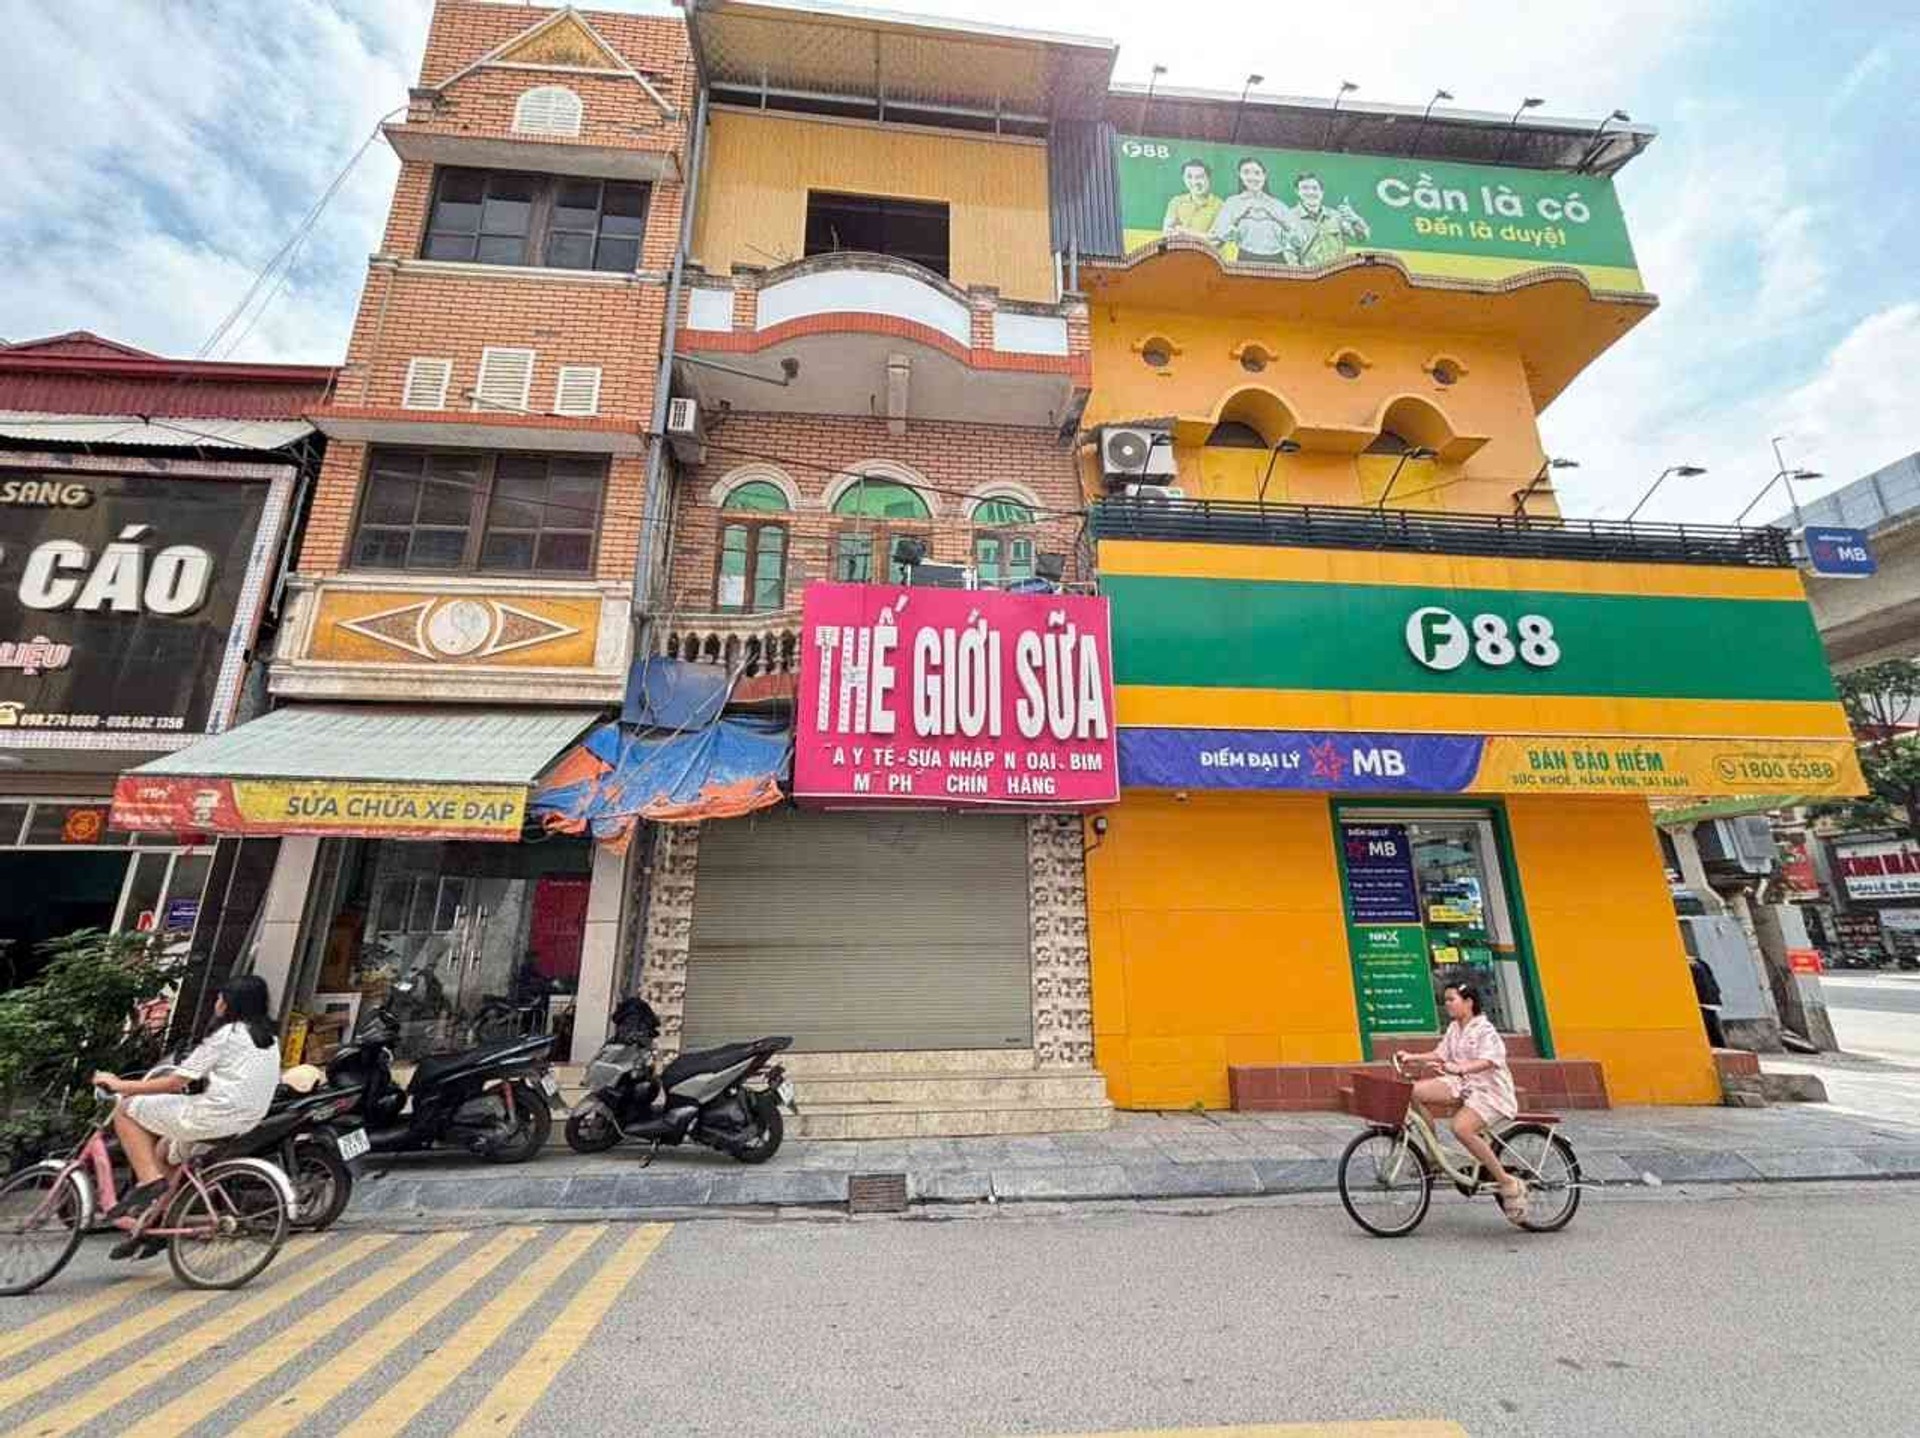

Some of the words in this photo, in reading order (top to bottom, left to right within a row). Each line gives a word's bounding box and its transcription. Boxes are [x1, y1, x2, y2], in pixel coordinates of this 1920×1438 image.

[1377, 173, 1469, 213] Cần
[1481, 184, 1525, 217] là
[1536, 192, 1590, 223] có
[1415, 215, 1463, 238] Đến
[1469, 220, 1494, 240] là
[1500, 224, 1566, 248] duyệt
[0, 481, 88, 504] SANG
[1837, 547, 1867, 562] MB
[18, 524, 211, 615] CÁO
[1406, 606, 1561, 670] F88
[815, 595, 908, 734] THẾ
[914, 609, 1001, 738] GIỚI
[1016, 610, 1109, 740] SỮA
[1200, 747, 1244, 768] ĐIỂM
[1248, 751, 1278, 772] ĐẠI
[1282, 750, 1300, 768] LÝ
[1352, 748, 1406, 776] MB
[1528, 745, 1567, 770] BÁN
[1573, 744, 1609, 771] BẢO
[1615, 744, 1664, 771] HIỂM
[1740, 761, 1784, 778] 1800
[424, 800, 456, 819] XE
[463, 801, 514, 825] ĐẠP
[1369, 841, 1397, 856] MB
